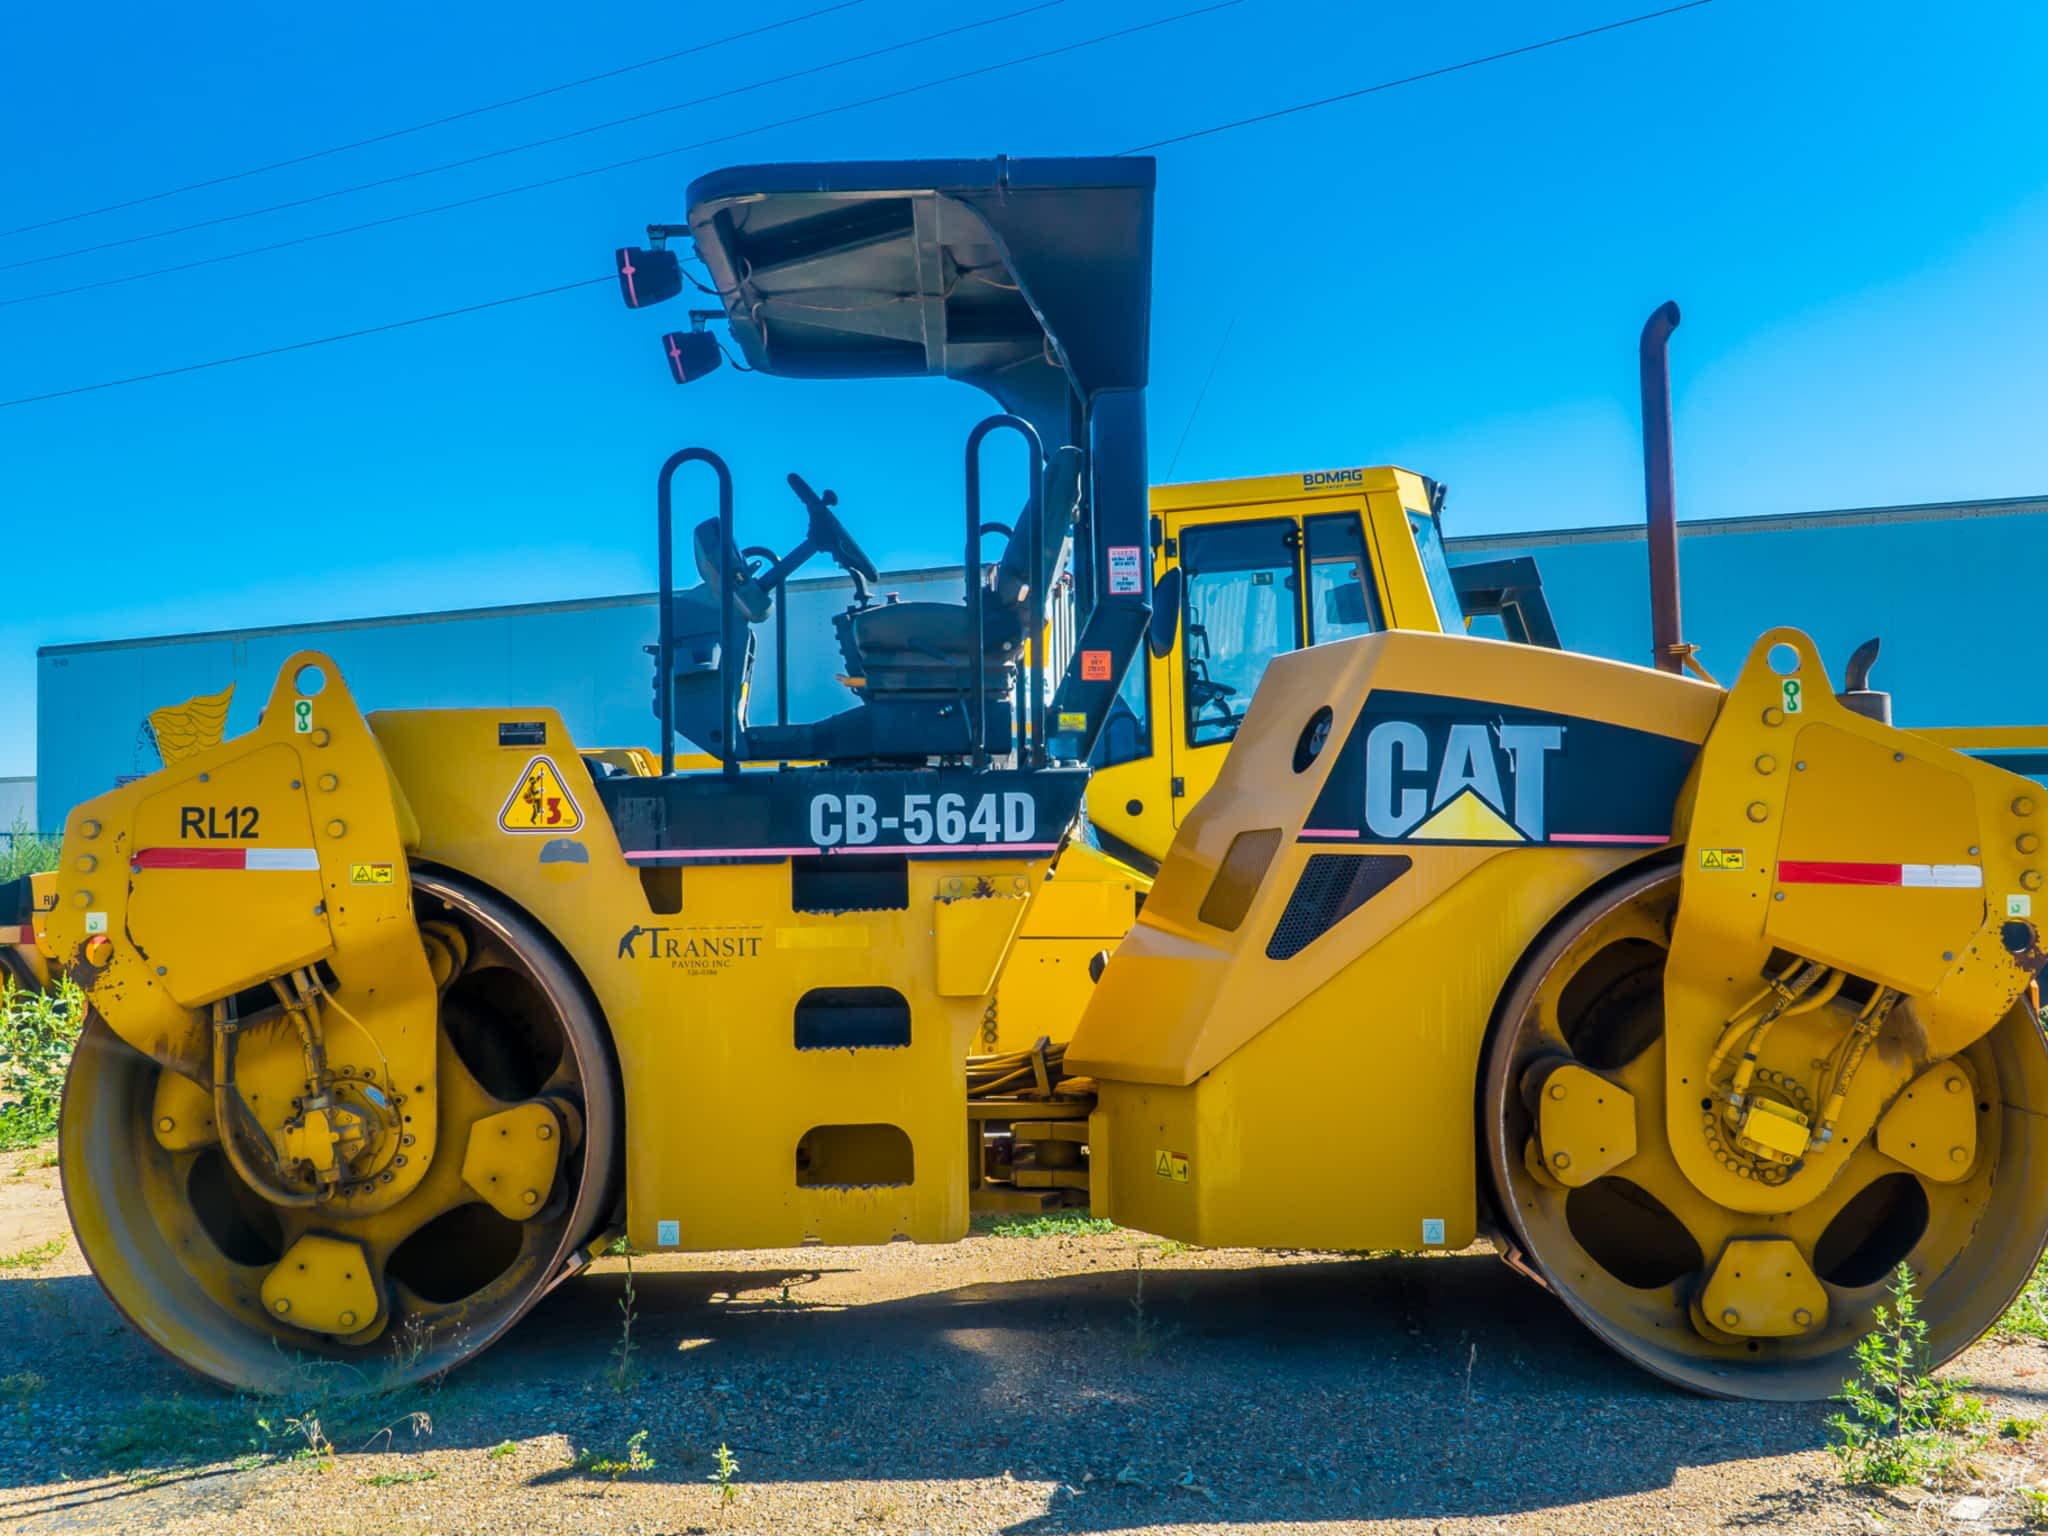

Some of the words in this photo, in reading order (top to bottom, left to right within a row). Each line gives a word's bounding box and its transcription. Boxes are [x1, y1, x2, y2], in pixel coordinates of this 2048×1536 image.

[1304, 469, 1363, 485] BOMAG
[1365, 720, 1562, 842] CAT
[181, 806, 259, 839] RL12
[547, 798, 562, 825] 3
[810, 791, 1036, 846] CB-564D
[672, 960, 709, 968] PAVING
